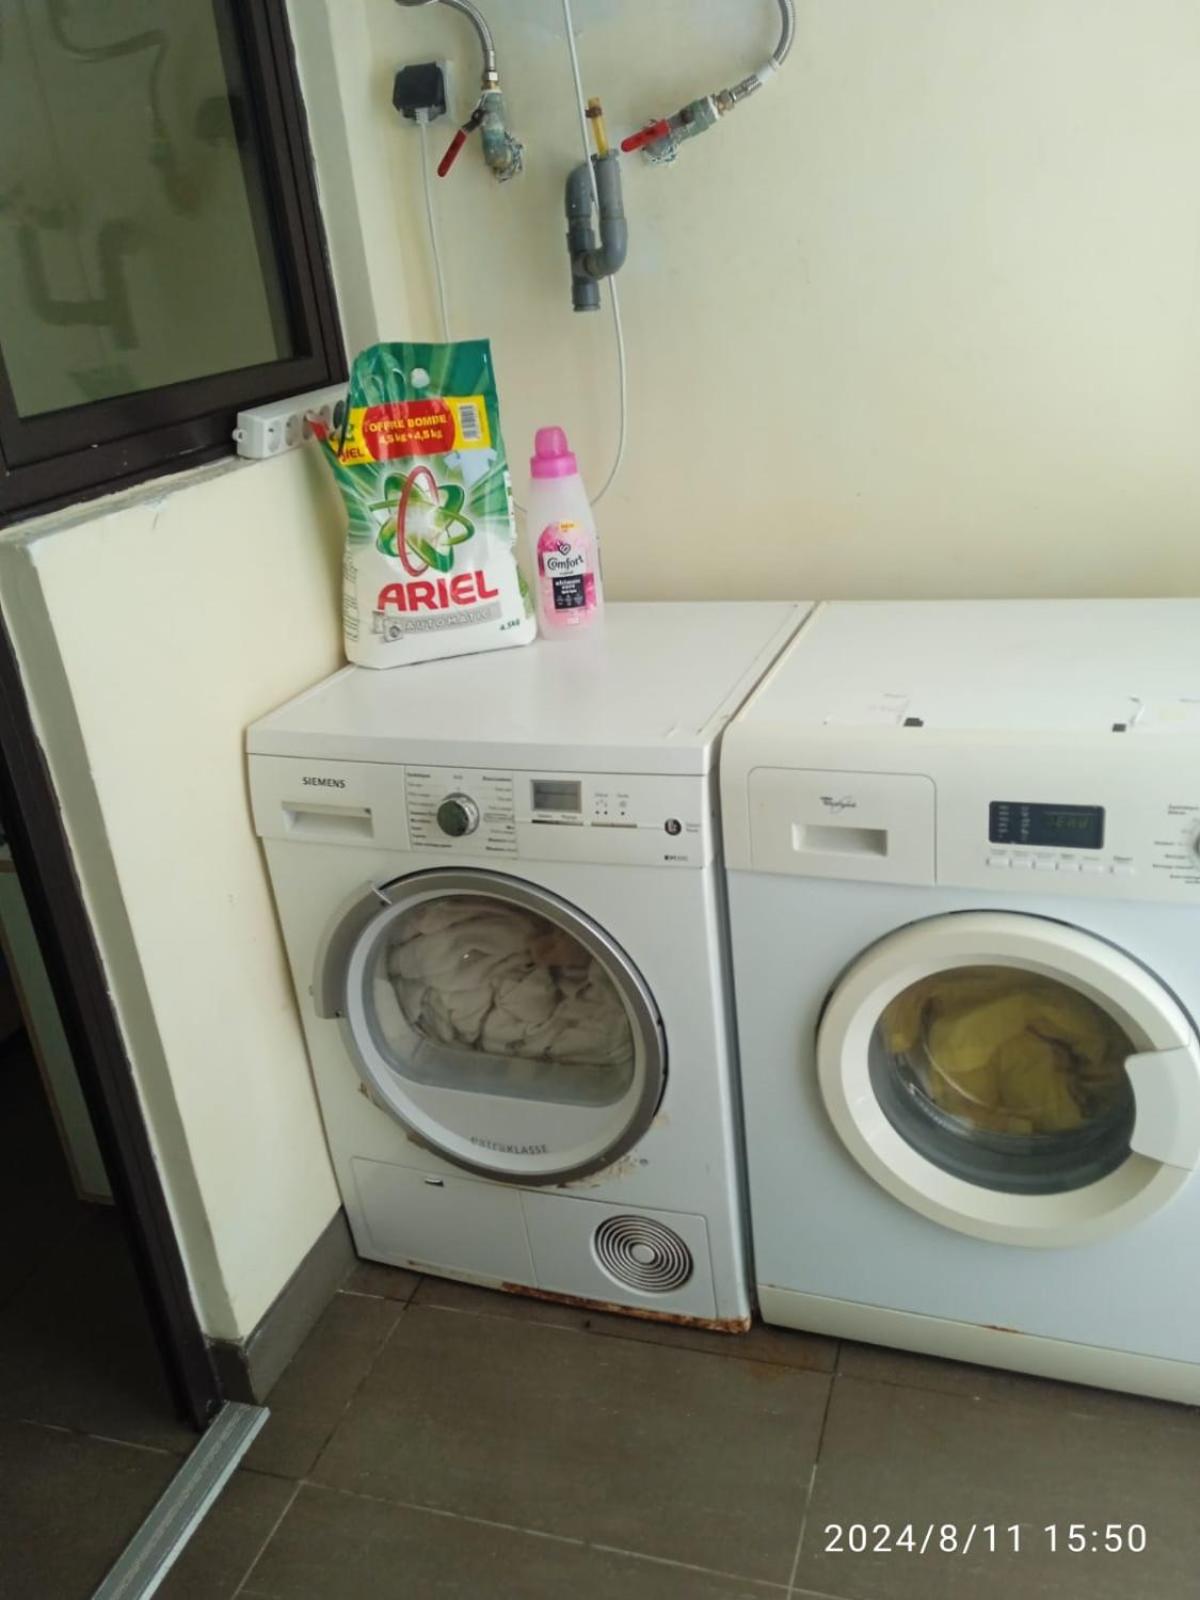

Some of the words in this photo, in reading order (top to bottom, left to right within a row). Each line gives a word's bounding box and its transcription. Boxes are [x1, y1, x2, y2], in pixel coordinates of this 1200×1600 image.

[369, 419, 407, 433] OFFRE
[408, 414, 447, 428] BOMBE
[546, 555, 584, 571] Comfort
[377, 570, 499, 611] ARIEL
[302, 776, 346, 789] SIEMENS
